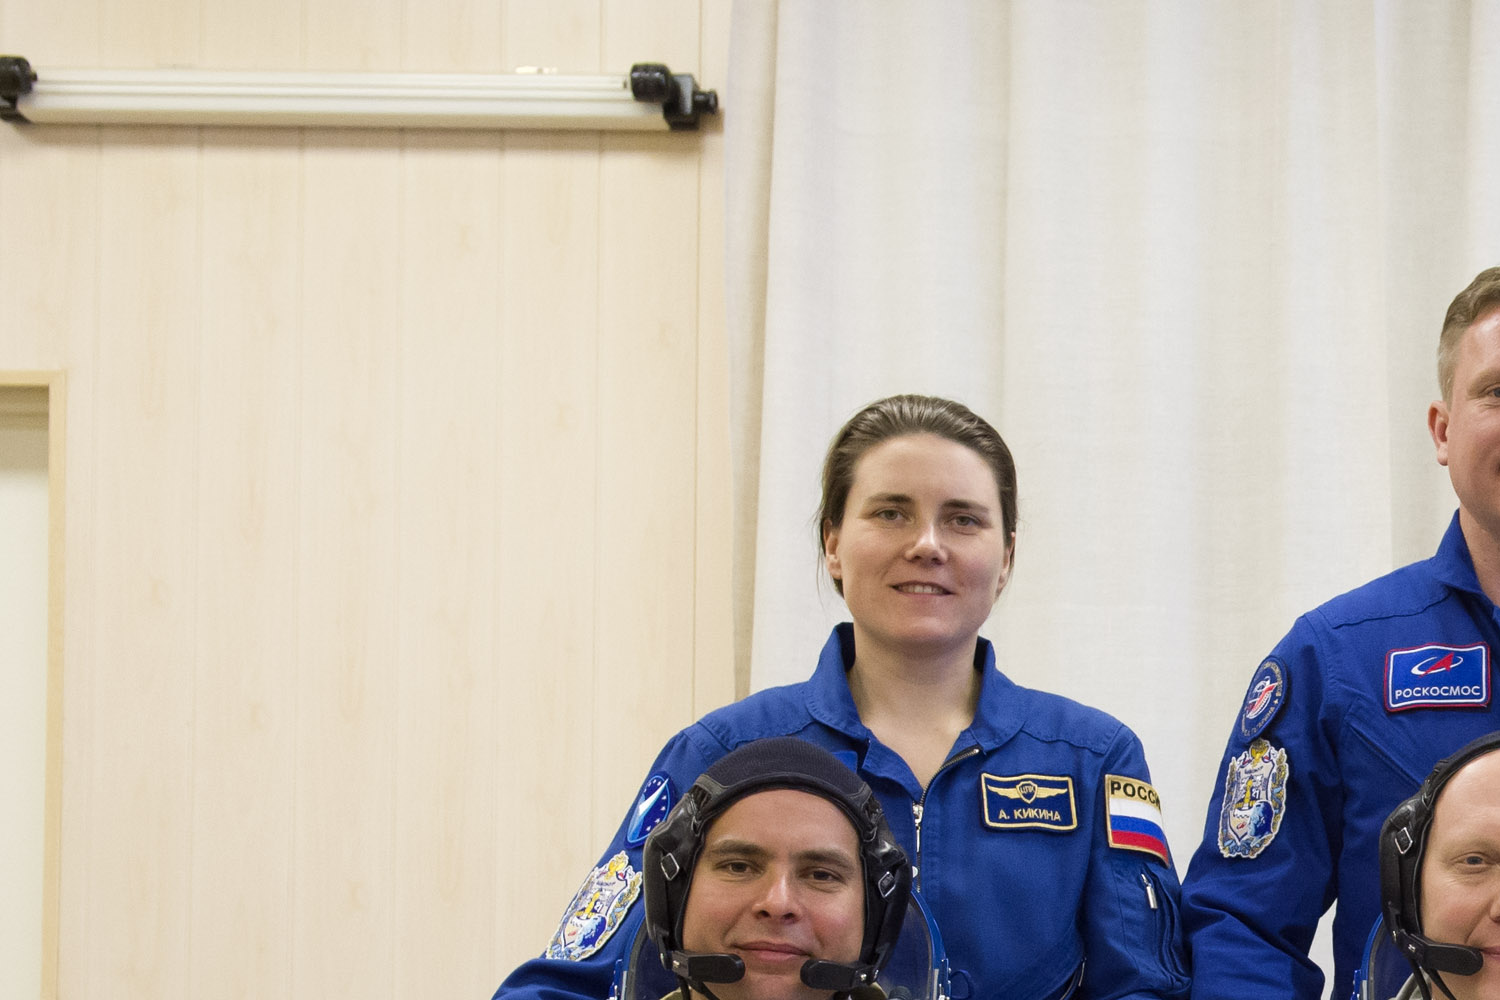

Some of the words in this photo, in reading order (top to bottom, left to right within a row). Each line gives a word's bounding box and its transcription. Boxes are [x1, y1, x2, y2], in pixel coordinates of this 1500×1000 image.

[1395, 685, 1481, 700] РОСКОСМОС
[998, 809, 1010, 820] А.
[1014, 808, 1061, 822] КИКИНА
